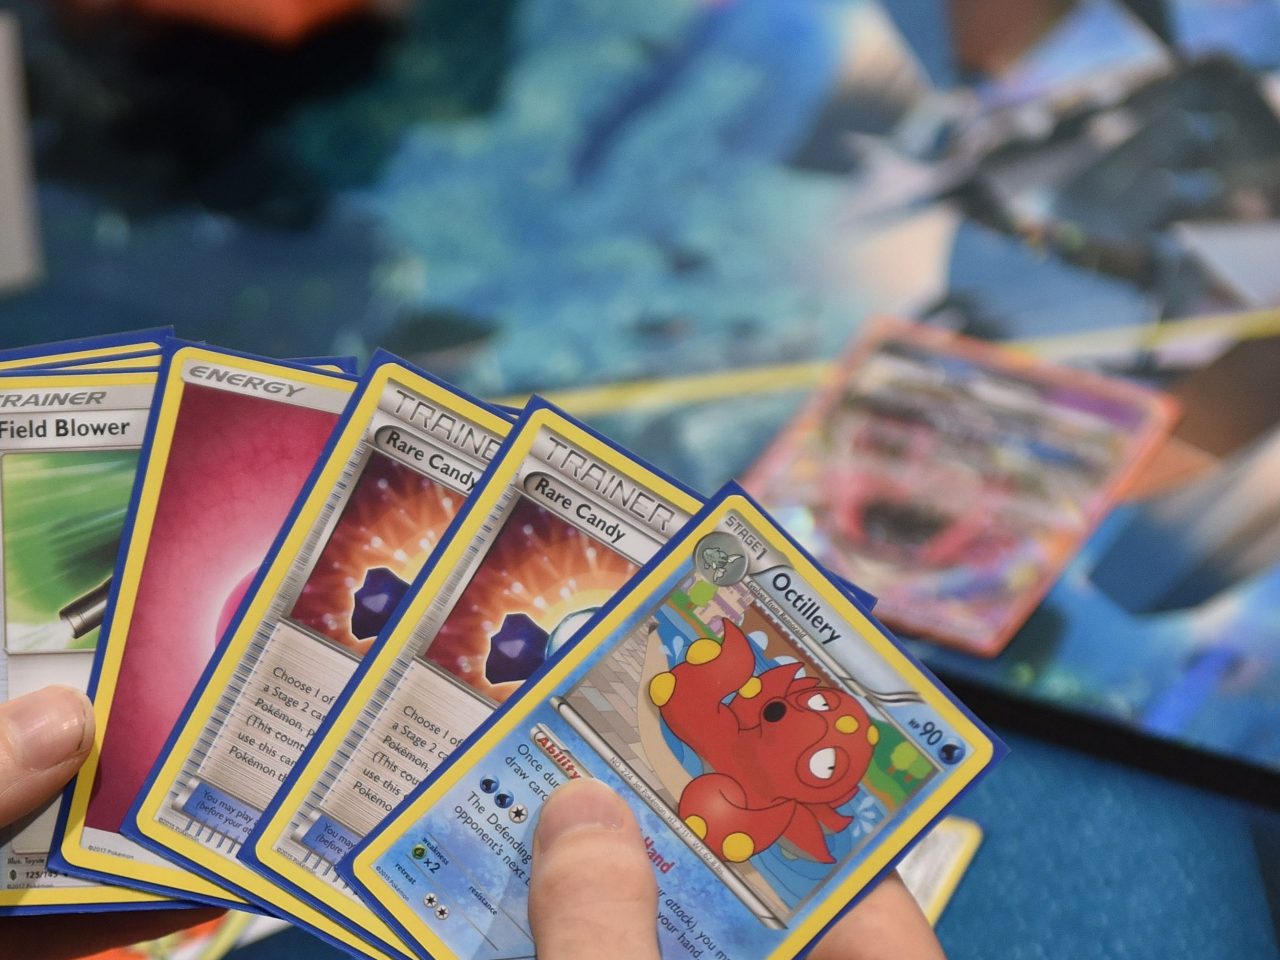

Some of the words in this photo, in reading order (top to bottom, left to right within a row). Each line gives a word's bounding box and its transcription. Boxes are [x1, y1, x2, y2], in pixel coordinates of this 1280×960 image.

[188, 364, 307, 398] ENERGY
[55, 418, 131, 438] Blower
[396, 388, 503, 463] TRAINE
[385, 430, 425, 462] Rare
[428, 453, 478, 493] Candy
[543, 436, 676, 532] TRAINER
[534, 476, 572, 510] Rare
[575, 502, 626, 544] Candy
[747, 580, 768, 601] Evolves
[766, 599, 781, 614] from
[772, 572, 842, 646] Octillery
[263, 683, 269, 693] a
[271, 686, 299, 708] Stage
[301, 701, 310, 713] 2
[310, 711, 327, 721] car
[272, 666, 312, 694] Choose
[321, 695, 335, 706] of
[254, 697, 304, 732] Pokémon,
[403, 705, 441, 735] Choose
[449, 736, 464, 748] of
[908, 718, 921, 729] HP
[919, 721, 943, 746] 90
[238, 731, 256, 747] use
[258, 742, 277, 758] this
[280, 755, 296, 768] car
[246, 713, 272, 735] (This
[275, 732, 307, 753] count
[392, 721, 399, 730] a
[400, 724, 427, 747] Stage
[428, 742, 437, 753] 2
[437, 751, 449, 761] ca
[228, 745, 276, 778] Pokémon
[372, 751, 398, 773] (This
[400, 770, 421, 786] cou
[382, 735, 429, 773] Pokémon,
[505, 756, 529, 780] draw
[517, 743, 543, 773] Once
[543, 771, 560, 789] dur
[536, 737, 581, 780] Ability
[352, 781, 393, 813] Pokémo
[363, 767, 380, 782] use
[382, 780, 401, 796] this
[196, 801, 224, 820] (before
[224, 815, 241, 830] your
[202, 789, 220, 804] You
[219, 801, 236, 814] may
[236, 810, 253, 824] play
[323, 823, 339, 839] You
[339, 836, 356, 850] may
[454, 805, 504, 856] opponent's
[502, 855, 525, 879] next
[467, 790, 486, 814] The
[486, 812, 533, 865] Defending
[422, 836, 450, 866] weakness
[395, 862, 417, 886] retreat
[468, 885, 498, 916] resistance
[656, 912, 680, 934] your
[665, 898, 698, 933] attack),
[695, 930, 717, 952] you
